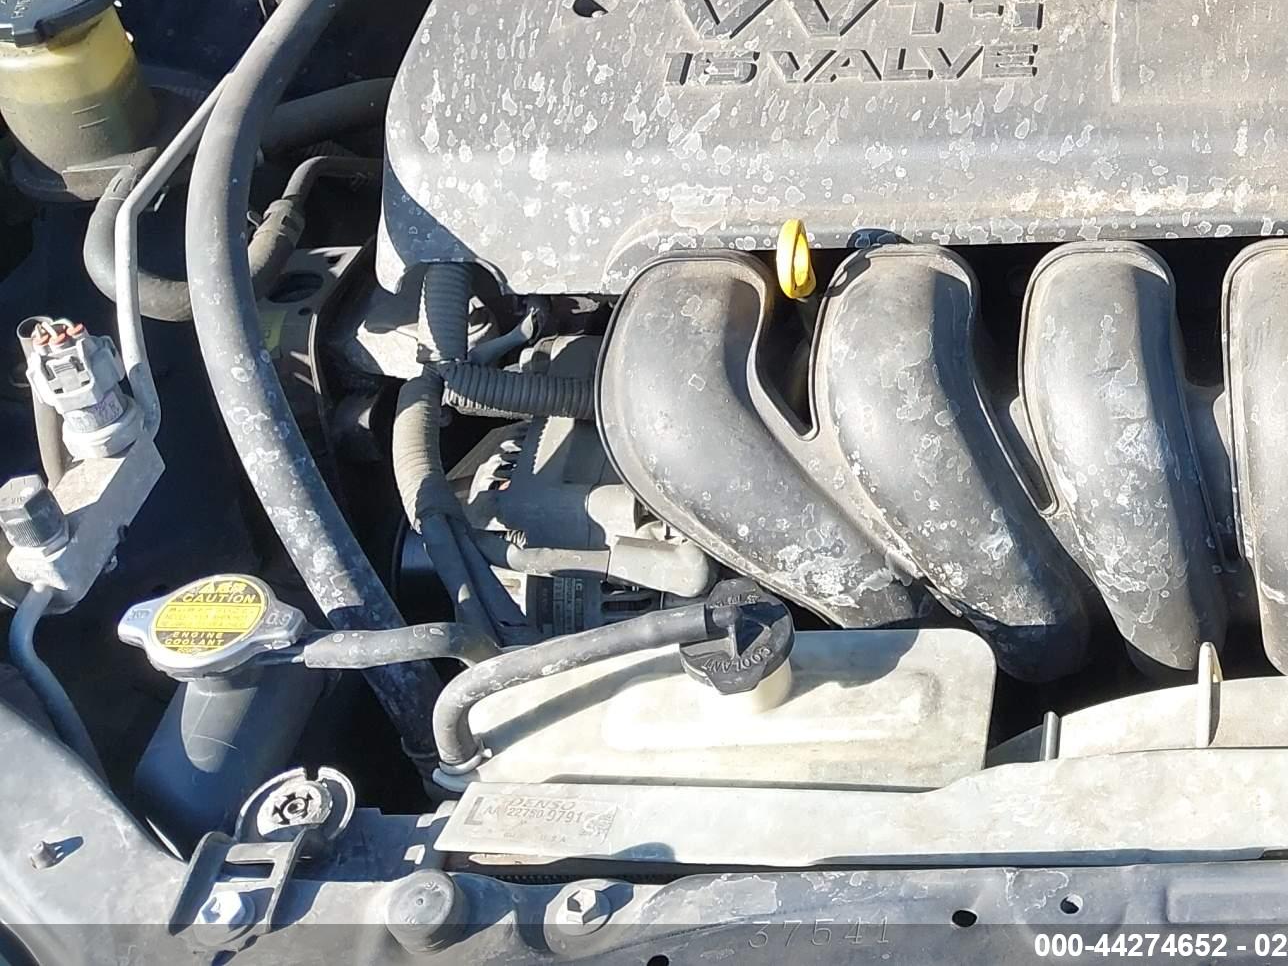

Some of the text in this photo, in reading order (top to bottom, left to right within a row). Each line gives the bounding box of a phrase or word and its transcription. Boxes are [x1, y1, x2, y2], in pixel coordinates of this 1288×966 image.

[770, 43, 1040, 85] VALVE
[182, 594, 257, 603] CAUTION
[702, 646, 774, 674] COOLANT
[508, 797, 577, 811] DENSO
[748, 915, 890, 949] 37541
